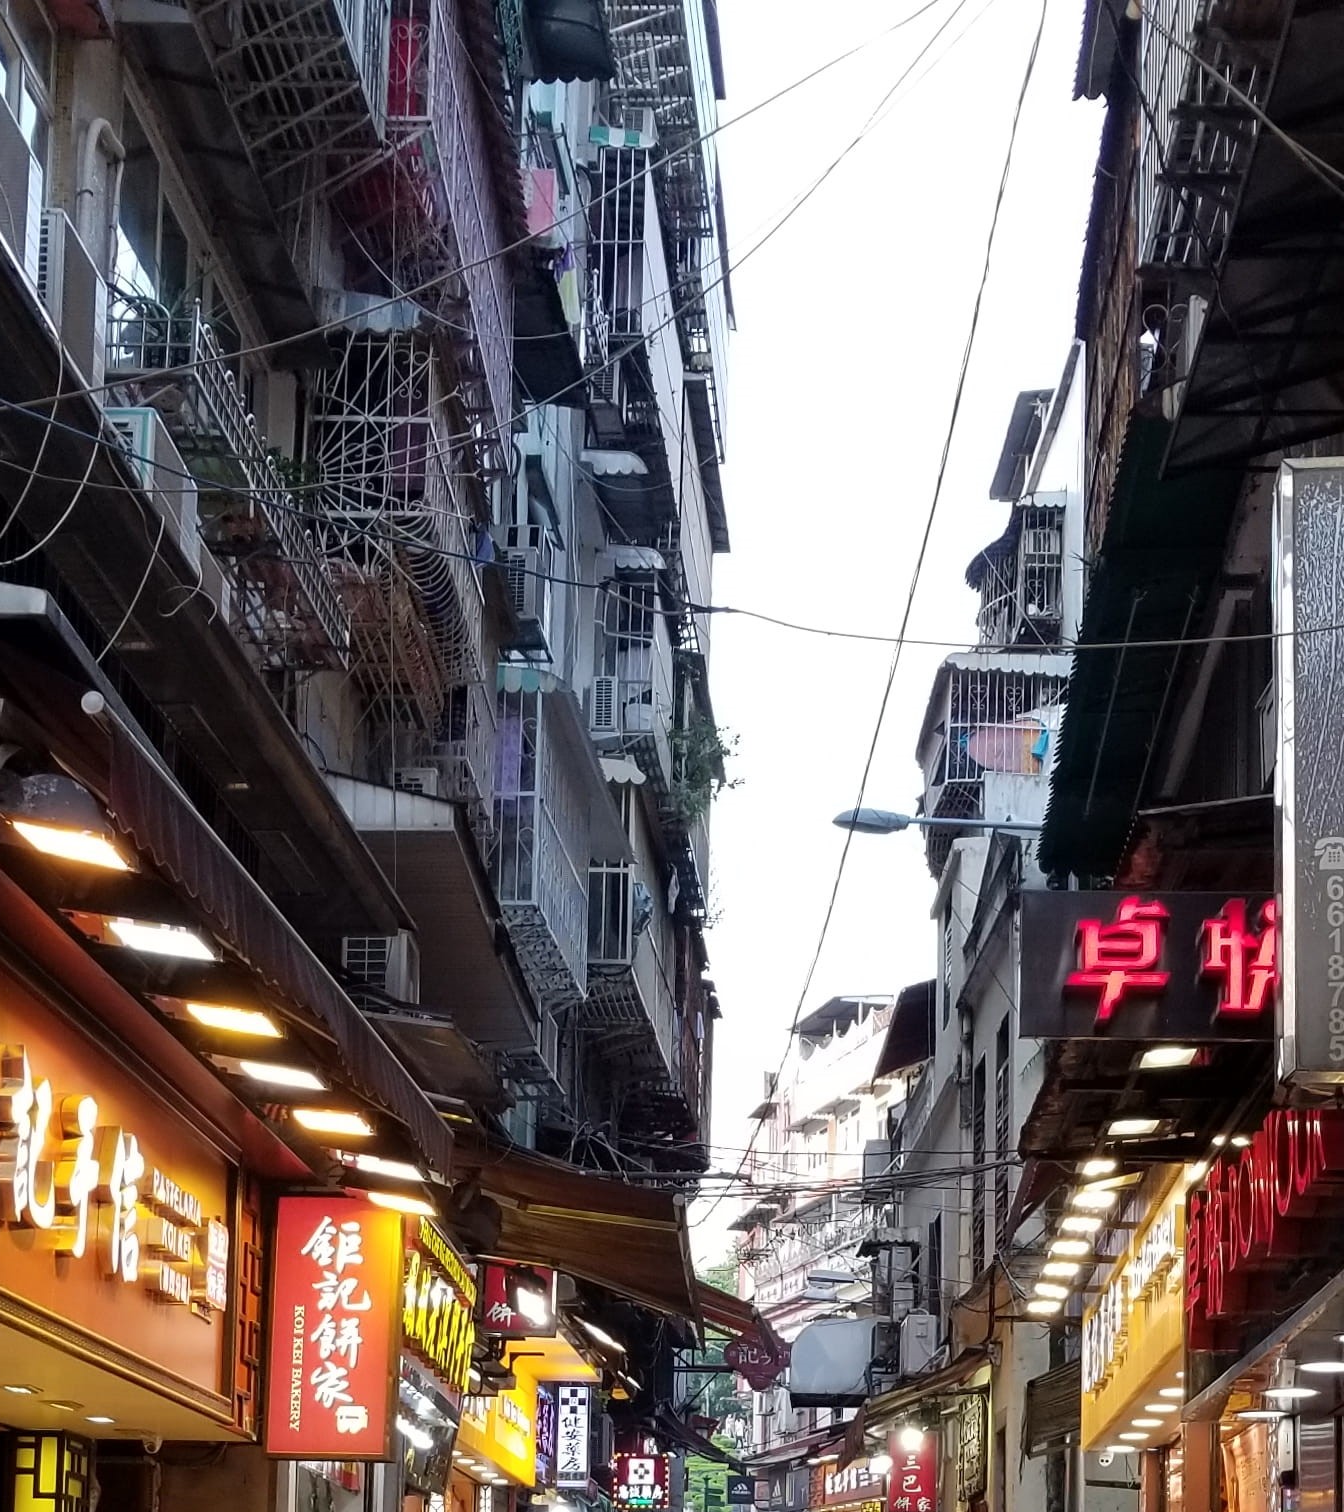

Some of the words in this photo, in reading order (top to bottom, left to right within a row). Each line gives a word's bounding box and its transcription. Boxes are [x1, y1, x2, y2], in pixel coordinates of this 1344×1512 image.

[153, 1168, 201, 1227] PASTELARIA
[1228, 1109, 1327, 1272] BONJOUR
[163, 1218, 176, 1254] KOI
[178, 1229, 191, 1262] KEI
[294, 1305, 305, 1333] KOI
[301, 1216, 372, 1408] 鉅記餅家
[292, 1336, 304, 1364] KEI
[289, 1367, 303, 1432] BAKERY
